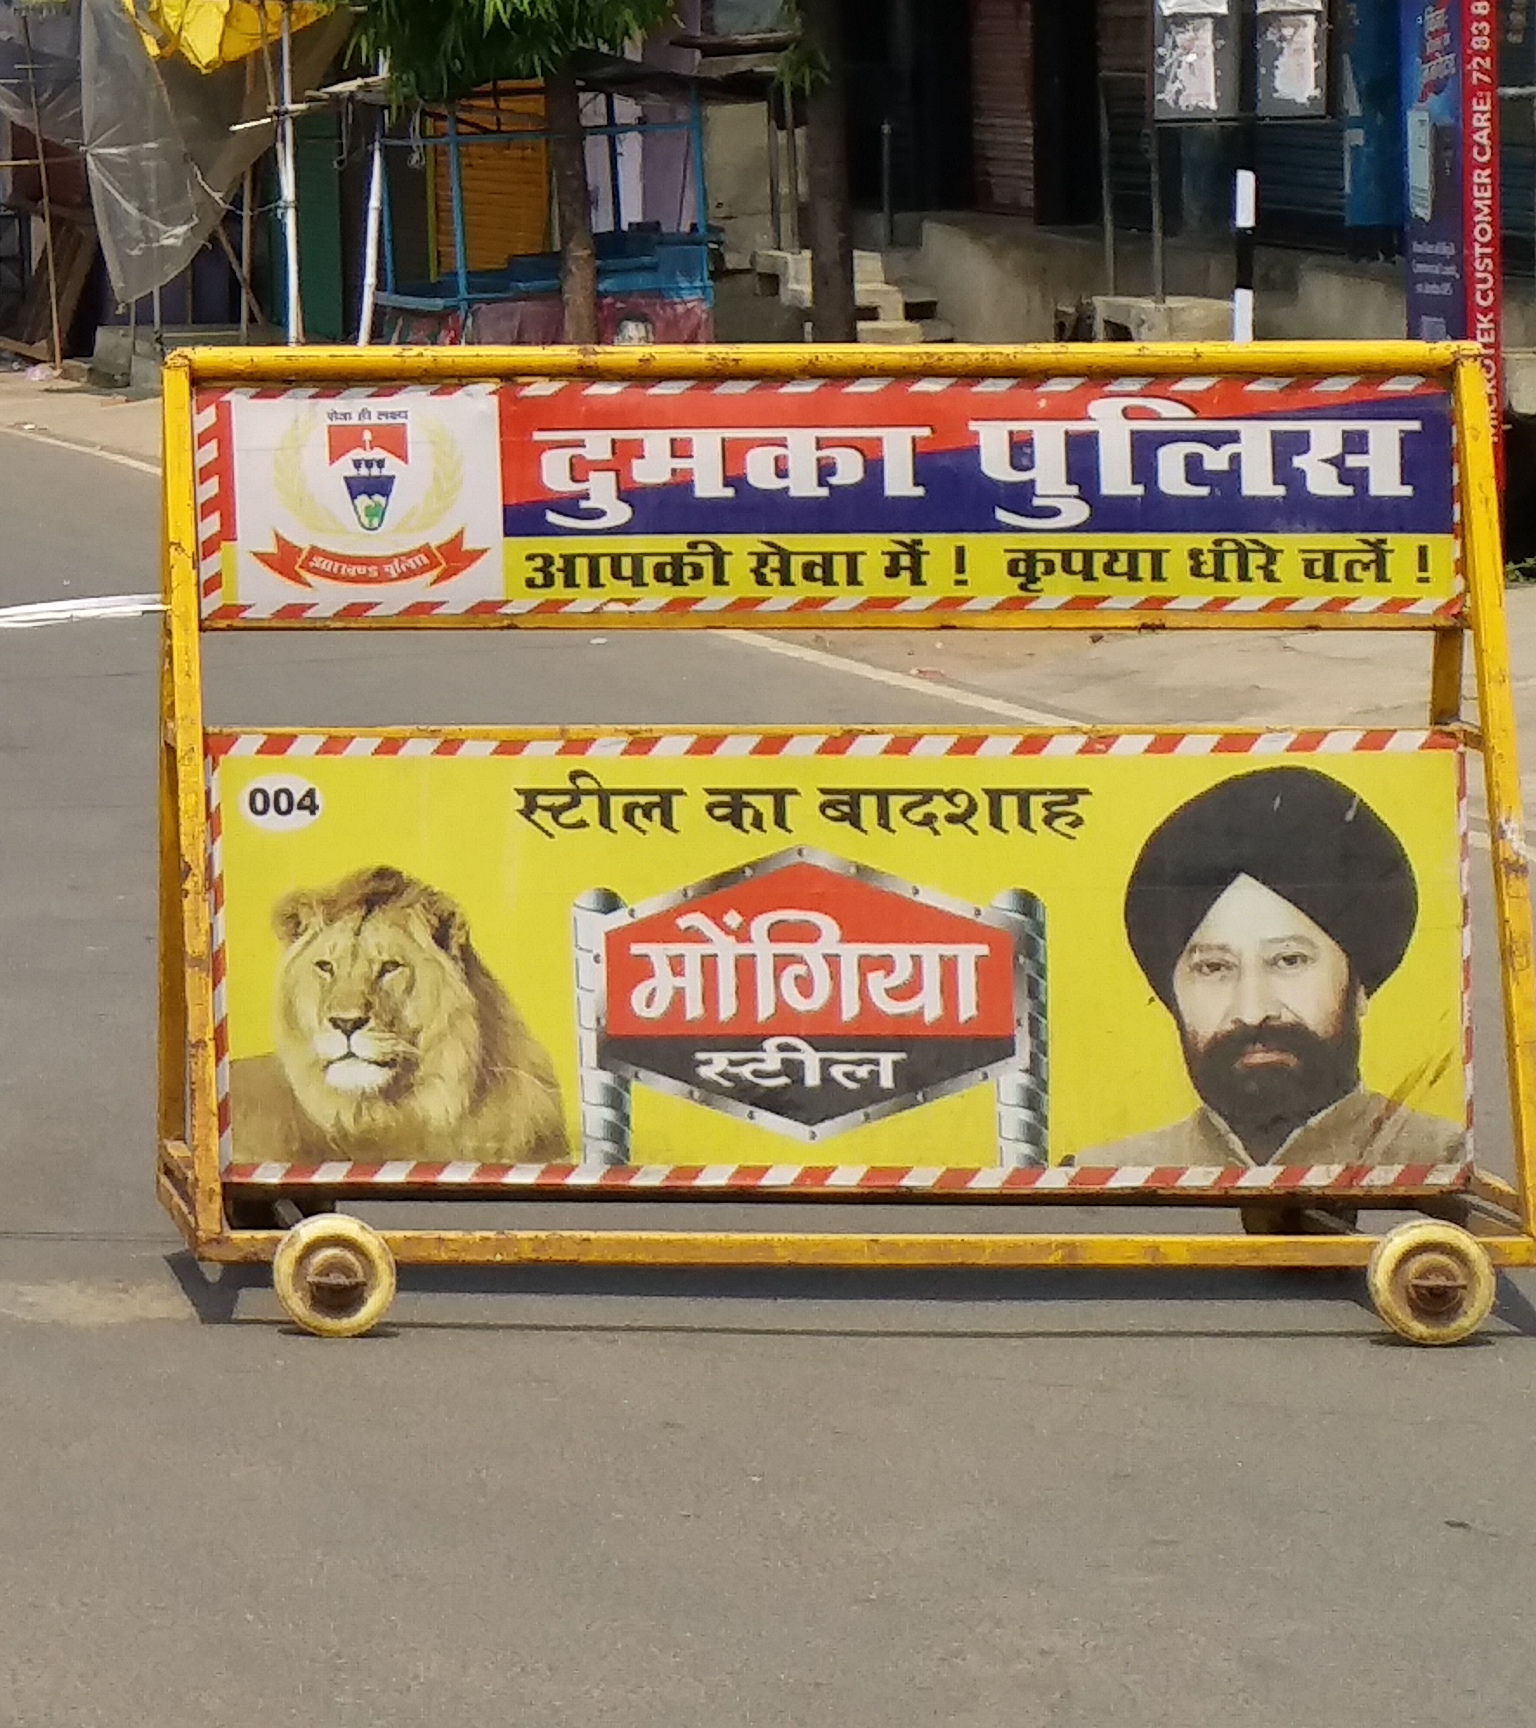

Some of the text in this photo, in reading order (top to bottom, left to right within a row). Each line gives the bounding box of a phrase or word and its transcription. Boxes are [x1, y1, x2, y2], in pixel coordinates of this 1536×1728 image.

[1470, 21, 1491, 51] 83
[1471, 55, 1493, 85] 72
[1471, 90, 1494, 164] CARE:
[1472, 168, 1496, 308] CUSTOMER
[532, 397, 1423, 530] दुमका पुलिस
[524, 538, 1431, 593] आपकी सेवा में ! कृपया धीरे चलें !
[246, 787, 320, 819] 004
[514, 771, 1092, 841] स्टील का बादशाह
[627, 909, 991, 1031] मोंगिया
[692, 1038, 909, 1092] स्टील
